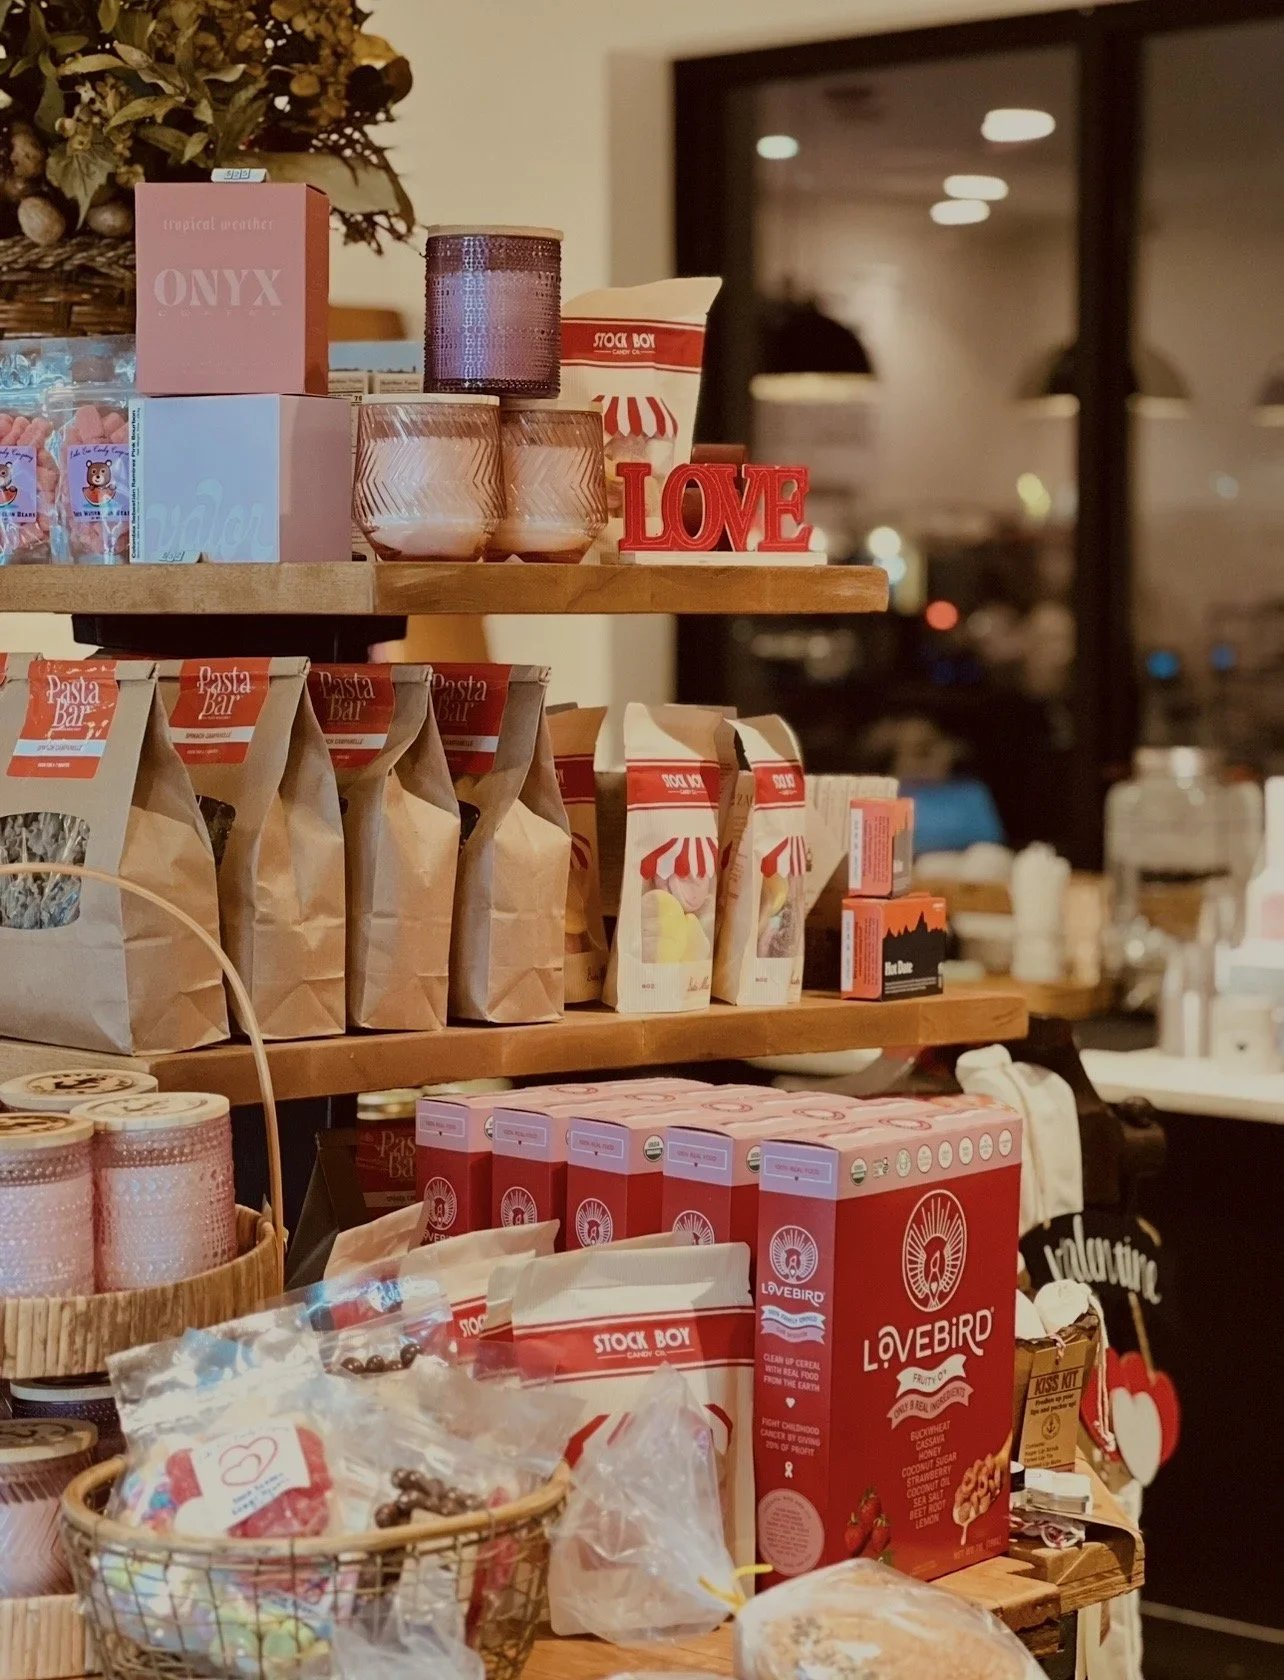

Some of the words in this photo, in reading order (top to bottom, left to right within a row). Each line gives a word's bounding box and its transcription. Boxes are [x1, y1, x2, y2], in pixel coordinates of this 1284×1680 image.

[163, 216, 215, 234] tropical
[221, 216, 274, 231] weather
[154, 268, 282, 307] ONYX
[593, 332, 628, 348] STOCK
[632, 333, 656, 348] BOY
[617, 462, 814, 552] LOVE
[46, 674, 100, 704] Pasta
[197, 666, 251, 694] Pasta
[319, 671, 376, 699] Pasta
[432, 673, 487, 701] Pasta
[52, 698, 93, 729] Bar
[198, 688, 240, 720] Bar
[327, 696, 366, 721] Bar
[437, 697, 475, 722] Bar
[376, 1131, 416, 1157] Pas
[388, 1152, 414, 1178] Ba
[593, 1330, 648, 1354] STOCK
[654, 1327, 690, 1348] BOY
[627, 1350, 652, 1359] CANDY
[763, 1353, 784, 1364] CLEAN
[785, 1357, 794, 1366] UP
[795, 1359, 820, 1371] CEREAL
[763, 1375, 782, 1385] FROM
[784, 1378, 796, 1388] THE
[797, 1381, 820, 1392] EARTH
[765, 1364, 782, 1375] WITH
[783, 1367, 799, 1378] REAL
[801, 1370, 819, 1381] FOOD
[913, 1373, 935, 1386] FRUITY
[1034, 1374, 1060, 1395] KISS
[1061, 1369, 1079, 1390] KIT
[893, 1400, 908, 1419] ONLY
[915, 1400, 929, 1413] REAL
[930, 1386, 966, 1413] INGREDIENTS
[760, 1428, 785, 1441] CANCER
[787, 1432, 796, 1442] BY
[798, 1434, 821, 1446] GIVING
[761, 1417, 780, 1428] FIGHT
[782, 1420, 820, 1436] CHILDHOOD
[911, 1420, 951, 1442] BUCKWHEAT
[781, 1443, 789, 1452] OF
[791, 1445, 815, 1457] PROFIT
[916, 1433, 945, 1452] CASSAVA
[918, 1446, 941, 1461] HONEY
[902, 1459, 934, 1478] COCONUT
[935, 1451, 957, 1468] SUGAR
[906, 1465, 952, 1488] STRAWBERRY
[907, 1480, 939, 1499] COCONUT
[940, 1476, 951, 1488] OIL
[913, 1495, 927, 1508] SEA
[928, 1488, 944, 1504] SALT
[909, 1506, 927, 1521] BEET
[928, 1499, 946, 1514] ROOT
[915, 1513, 939, 1529] LEMON
